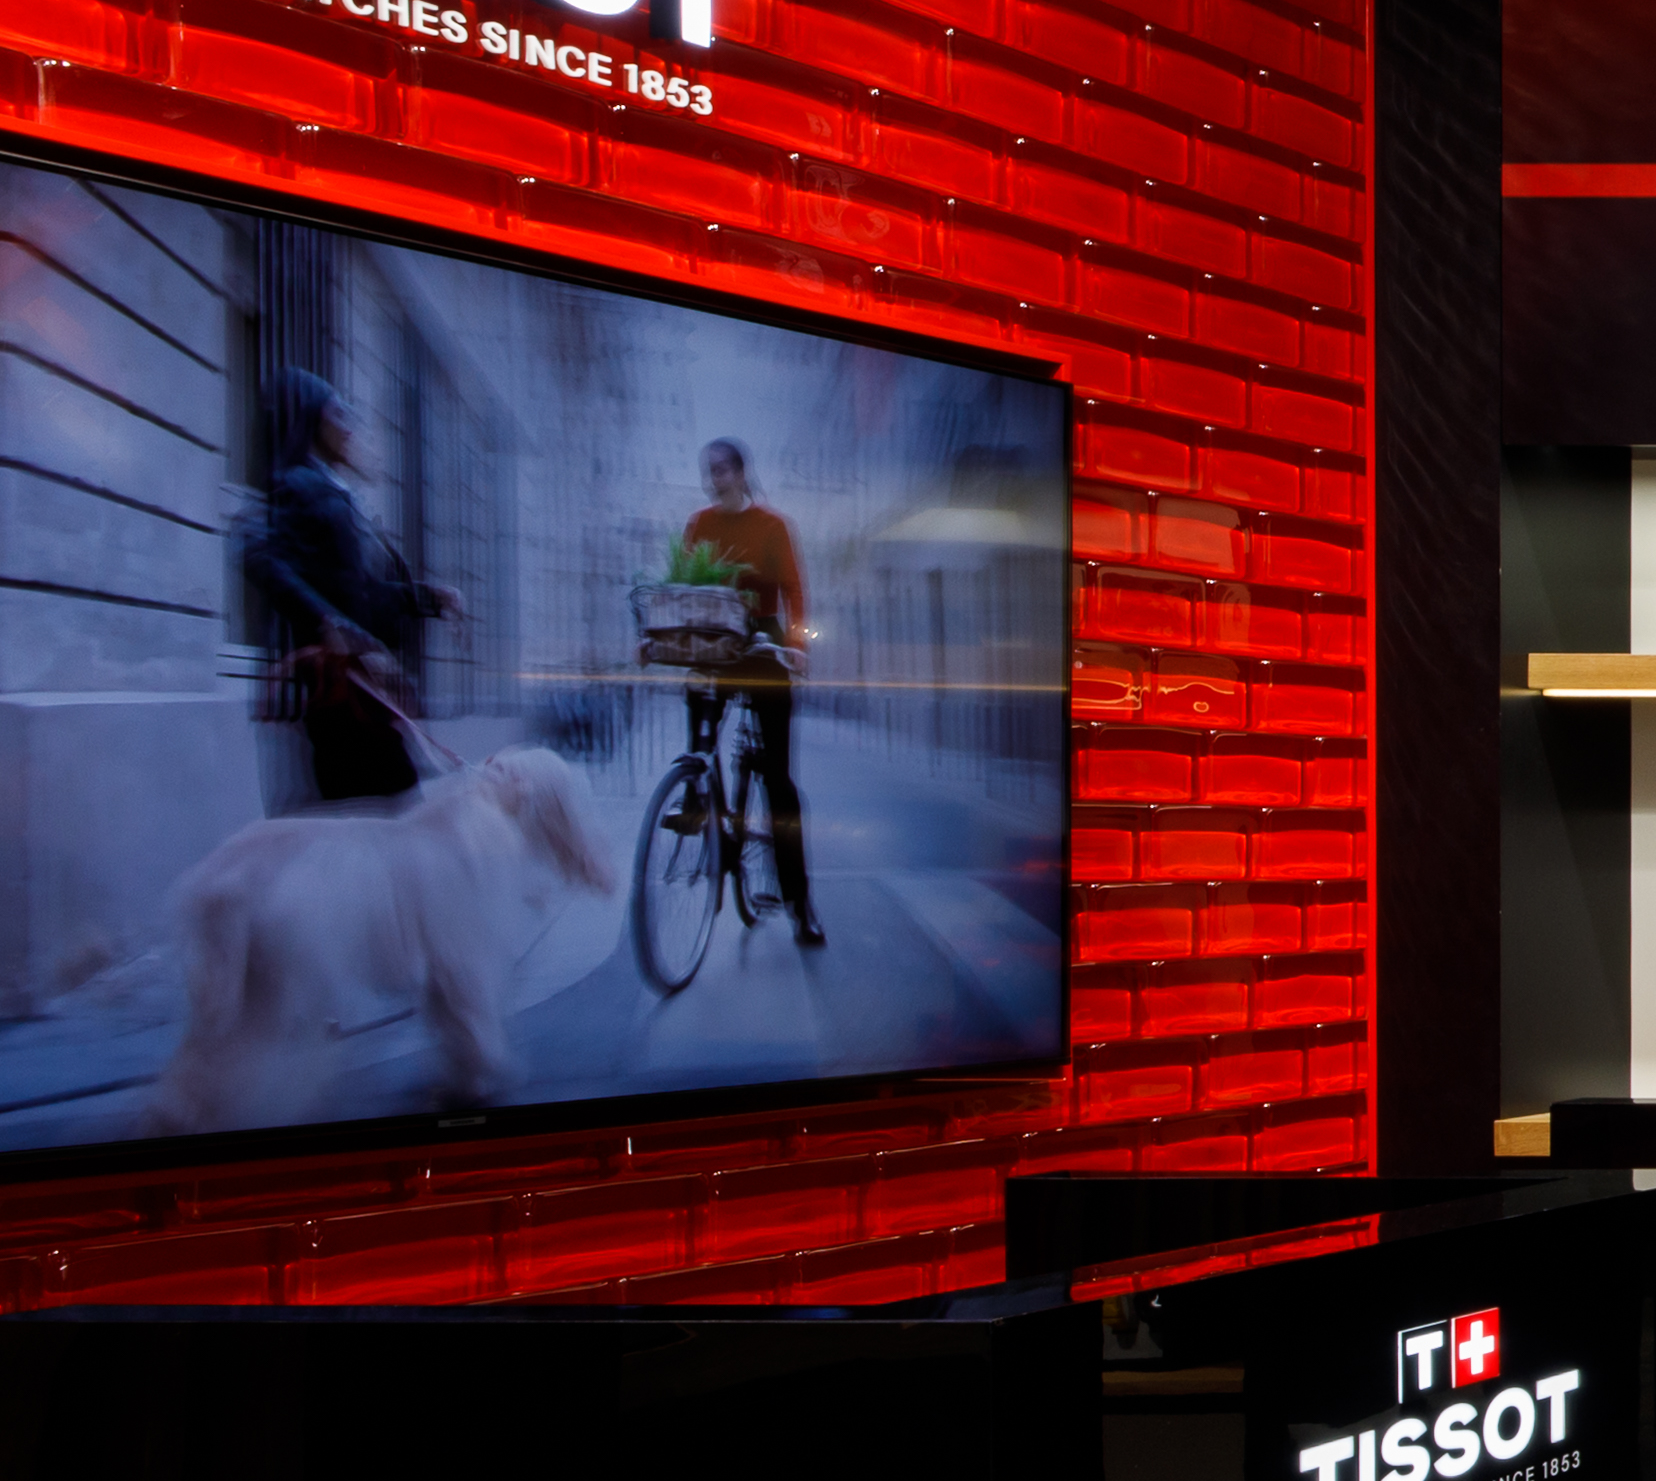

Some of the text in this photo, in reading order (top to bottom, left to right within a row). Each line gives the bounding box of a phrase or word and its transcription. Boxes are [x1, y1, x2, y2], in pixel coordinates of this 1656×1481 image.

[479, 20, 613, 87] SINCE
[622, 63, 714, 116] 1853
[1405, 1330, 1443, 1391] T
[1542, 1450, 1581, 1480] 1853
